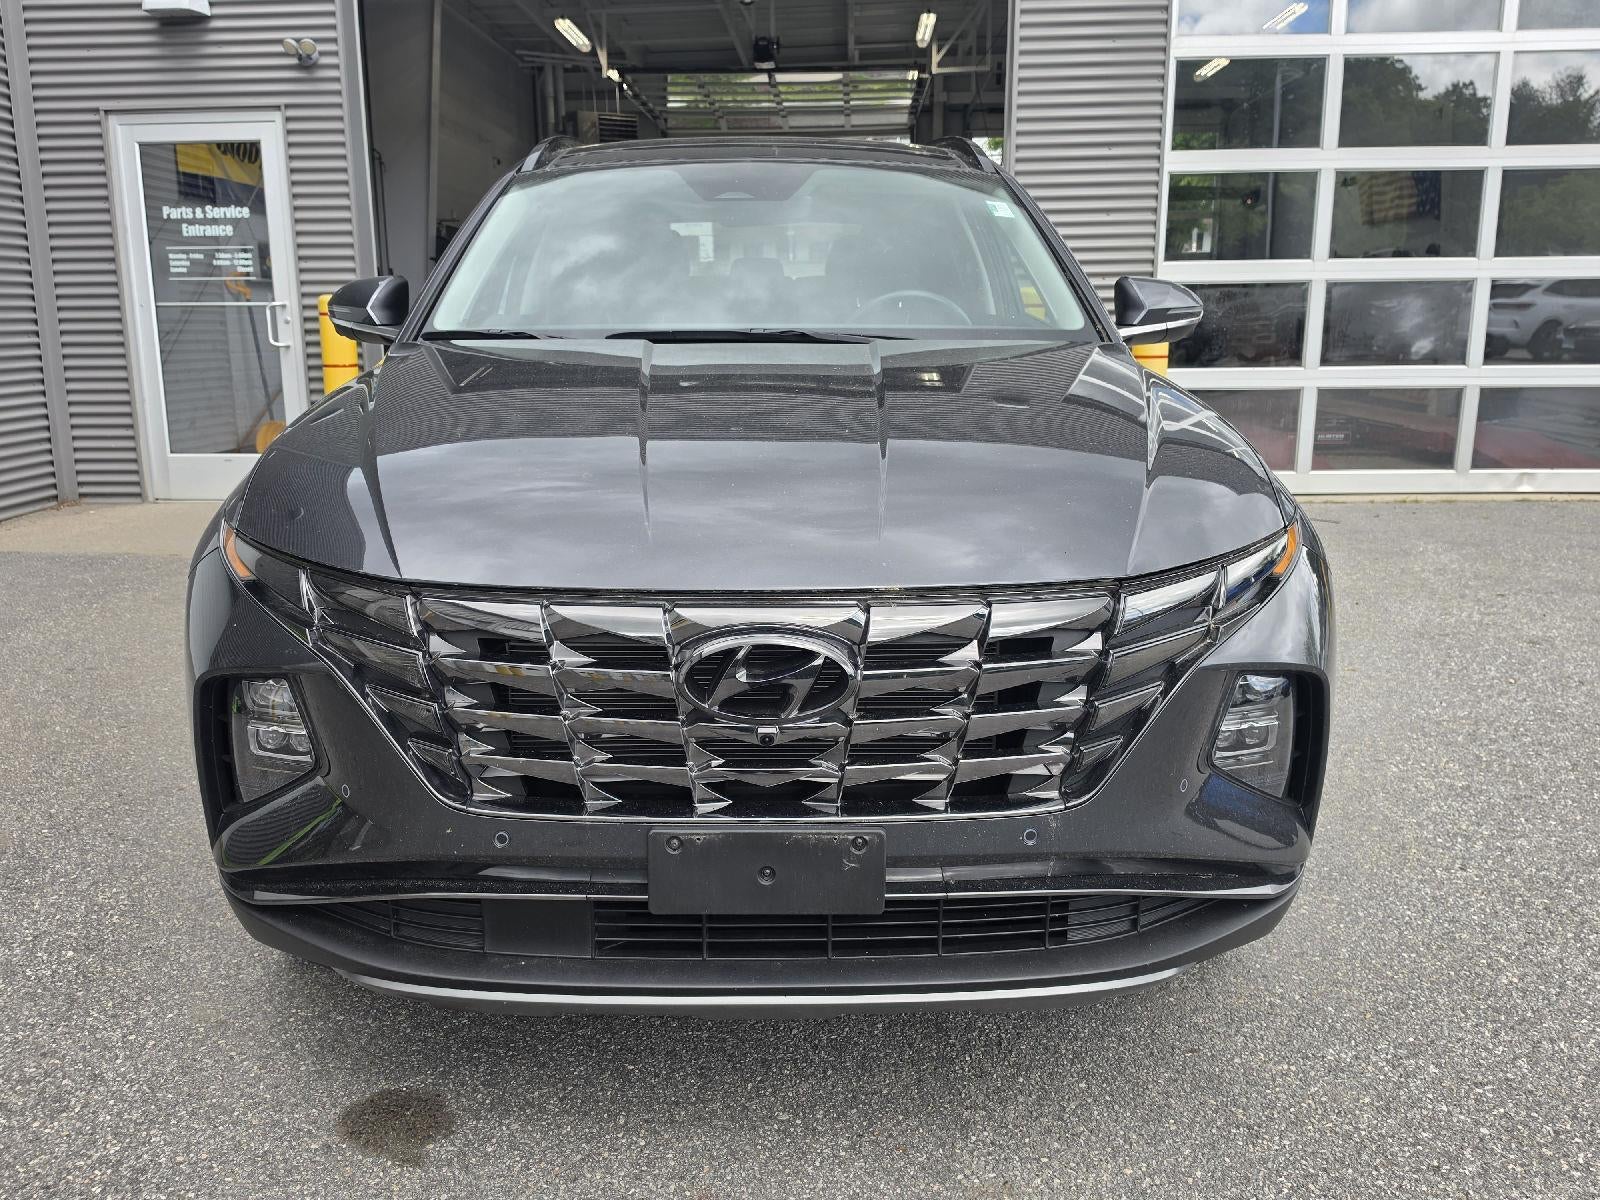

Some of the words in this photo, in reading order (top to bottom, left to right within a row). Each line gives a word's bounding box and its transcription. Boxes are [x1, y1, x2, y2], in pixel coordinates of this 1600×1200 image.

[162, 205, 193, 219] Parts
[195, 207, 204, 219] &
[205, 204, 250, 219] Service
[181, 223, 233, 237] Entrance
